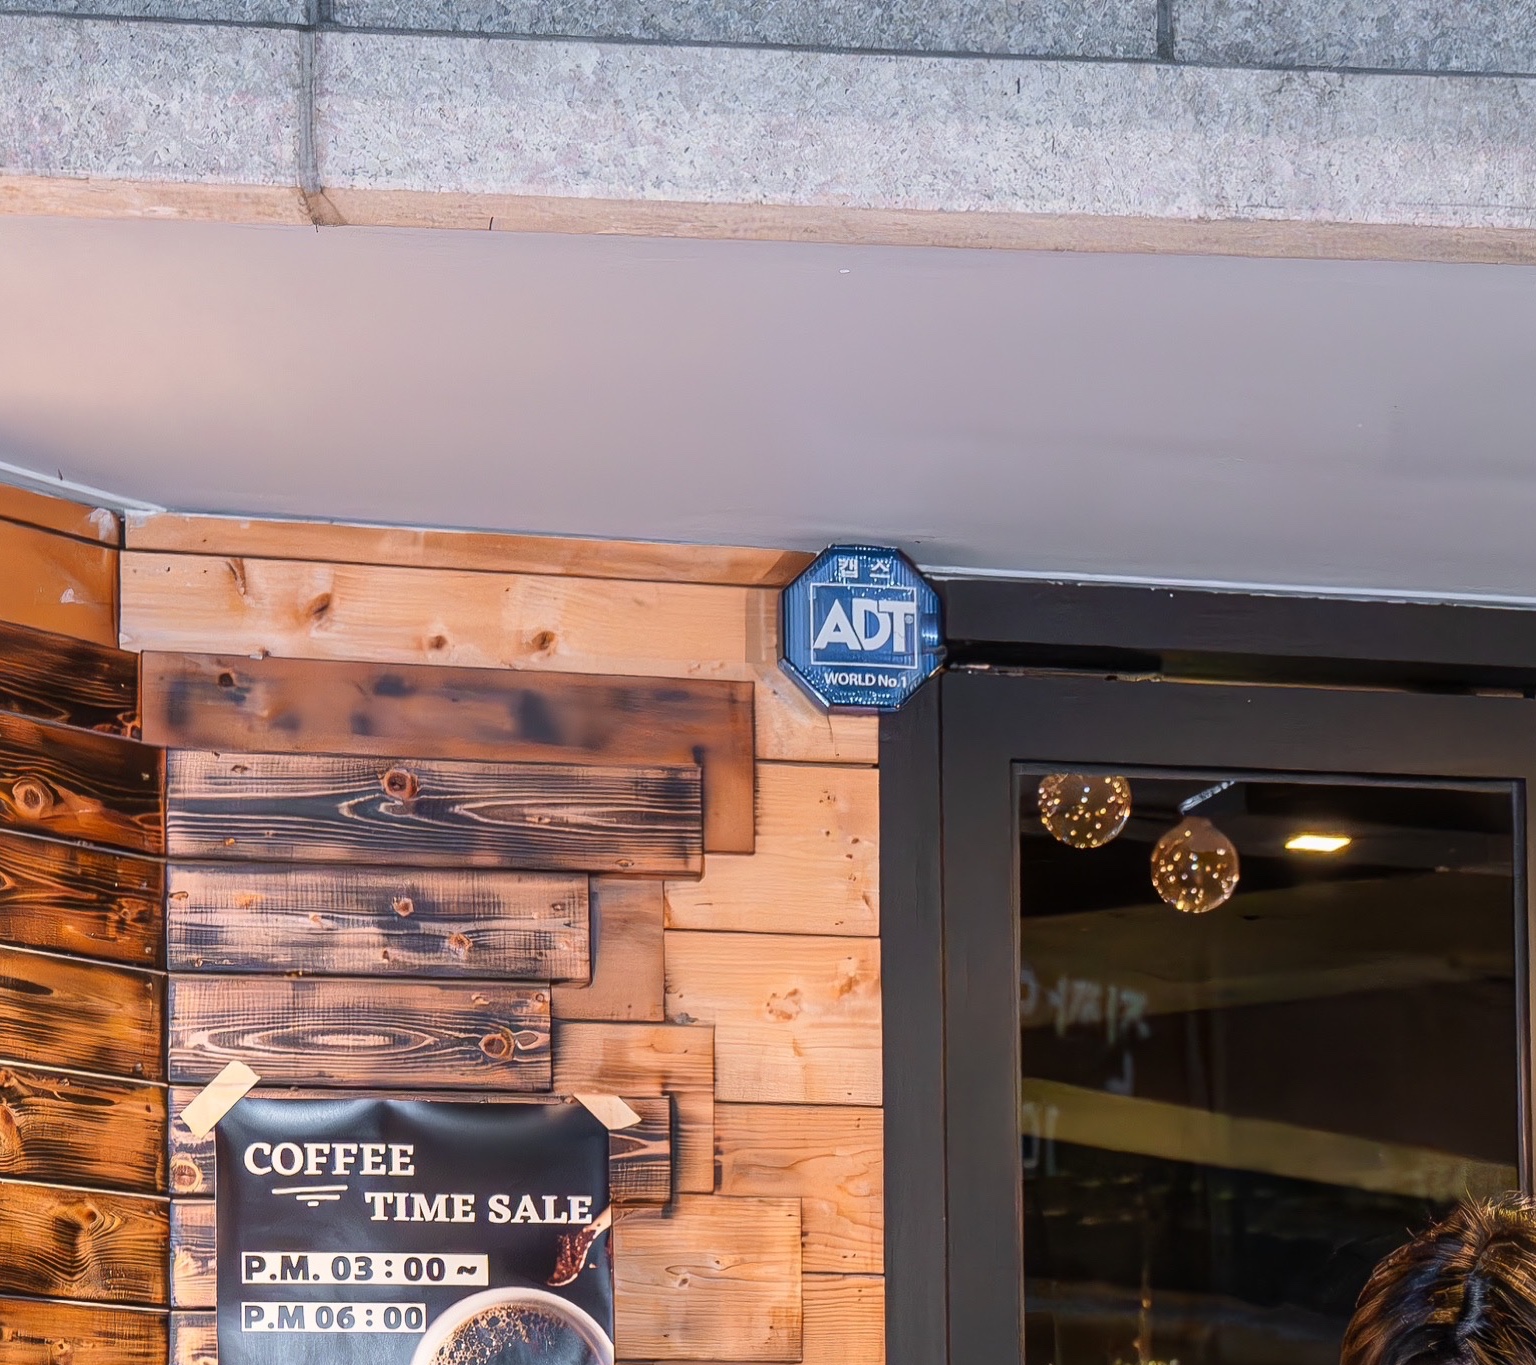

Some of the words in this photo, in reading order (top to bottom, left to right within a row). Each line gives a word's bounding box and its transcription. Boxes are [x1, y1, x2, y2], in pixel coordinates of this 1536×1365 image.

[813, 598, 917, 653] ADT
[824, 672, 876, 687] WORLD
[243, 1141, 415, 1177] COFFEE
[364, 1191, 476, 1223] TIME
[487, 1193, 594, 1225] SALE
[244, 1255, 320, 1282] P.M.
[244, 1304, 306, 1330] P.M
